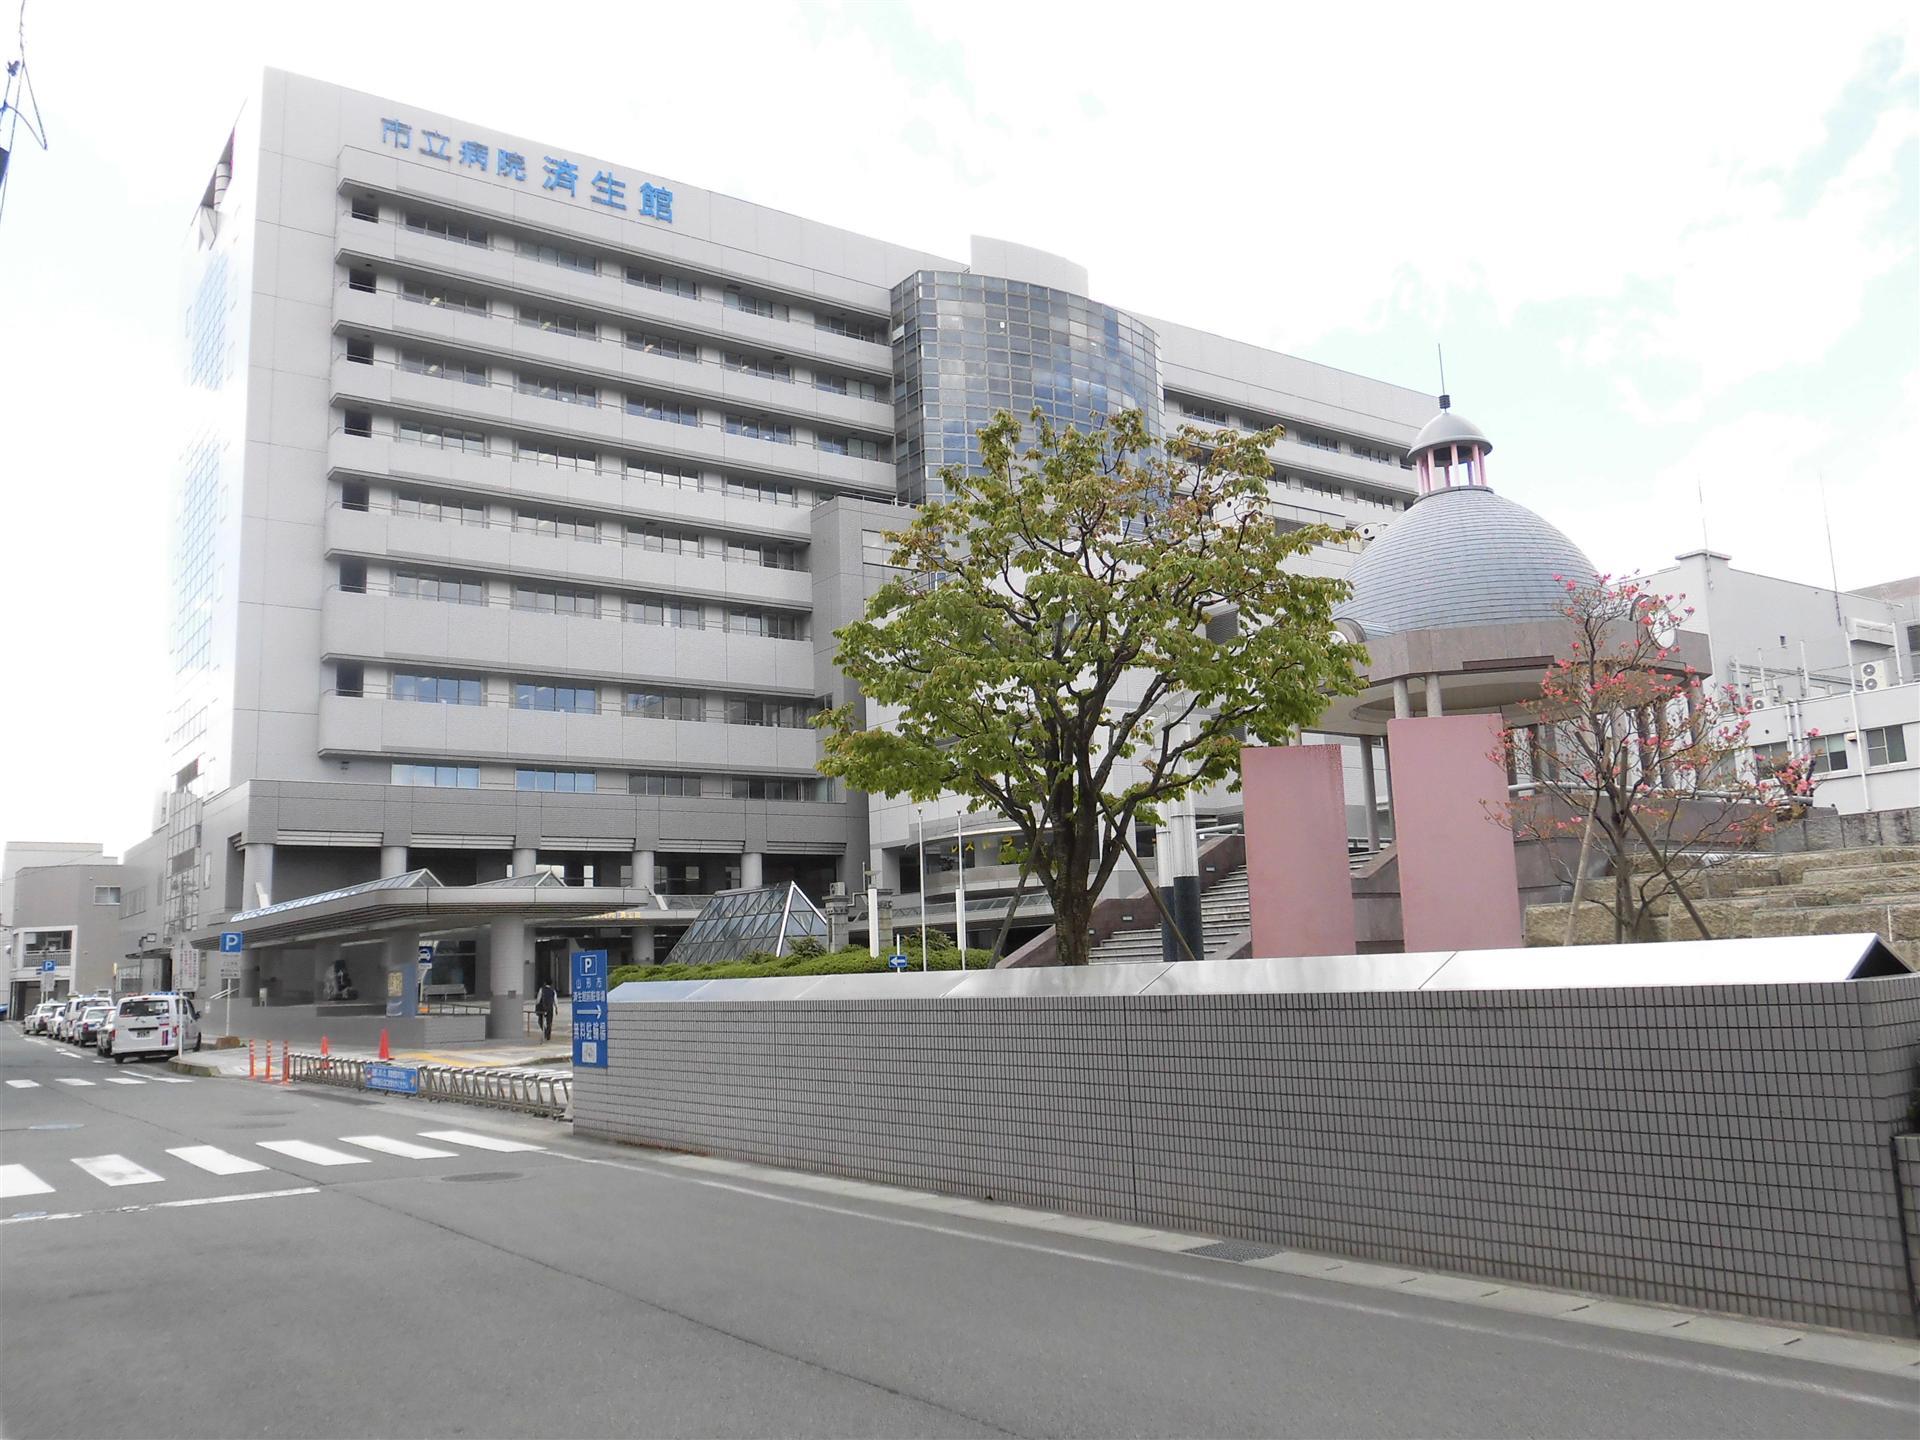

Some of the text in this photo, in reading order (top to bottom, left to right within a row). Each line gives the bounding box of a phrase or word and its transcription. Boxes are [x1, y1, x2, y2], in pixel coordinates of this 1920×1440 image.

[380, 117, 673, 224] 市立病院 済生館
[225, 934, 238, 951] P
[44, 961, 53, 971] P
[584, 957, 592, 973] P
[576, 978, 602, 989] 山形市
